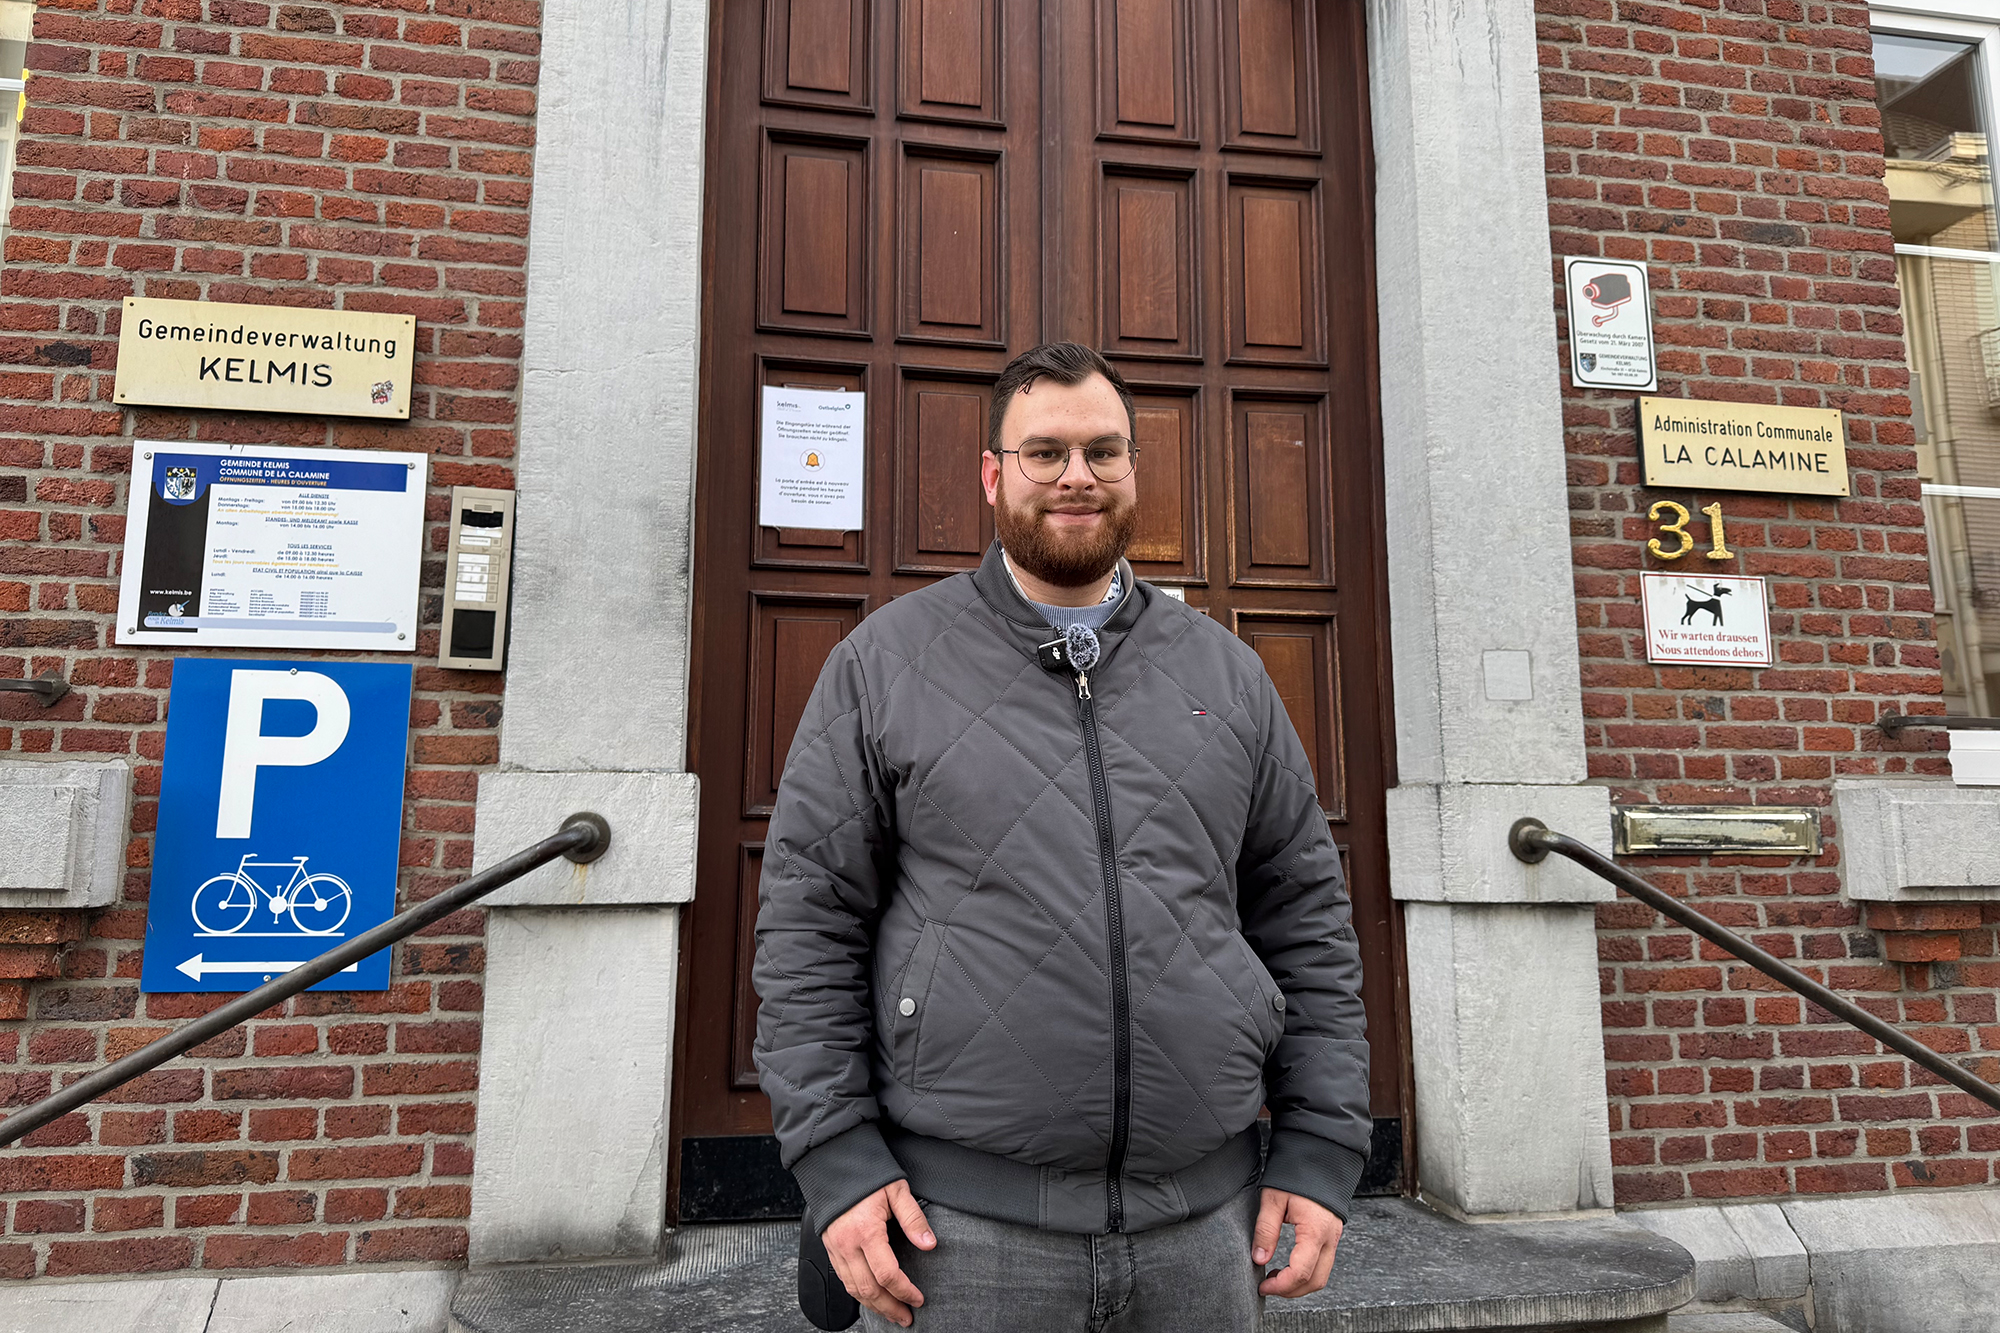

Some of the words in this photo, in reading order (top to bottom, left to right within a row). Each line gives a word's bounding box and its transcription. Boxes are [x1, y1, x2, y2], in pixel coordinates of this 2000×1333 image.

[138, 318, 396, 359] Gemeindeverwaltung
[1576, 330, 1611, 340] Überwachung
[200, 356, 332, 387] KELMIS
[1654, 414, 1752, 437] Administration
[1756, 421, 1832, 442] Communale
[220, 459, 260, 468] GEMEINDE
[263, 461, 290, 469] KELMIS
[1662, 444, 1692, 464] LA
[1704, 446, 1829, 473] CALAMINE
[220, 468, 262, 477] COMMUNE
[288, 471, 330, 479] CALAMINE
[1648, 500, 1734, 560] 31
[1658, 629, 1678, 640] Wir
[1680, 630, 1714, 641] warten
[1716, 632, 1758, 643] draussen
[1656, 644, 1682, 655] Nous
[1683, 646, 1730, 657] attendons
[1732, 646, 1764, 658] dehors
[216, 669, 350, 839] P
